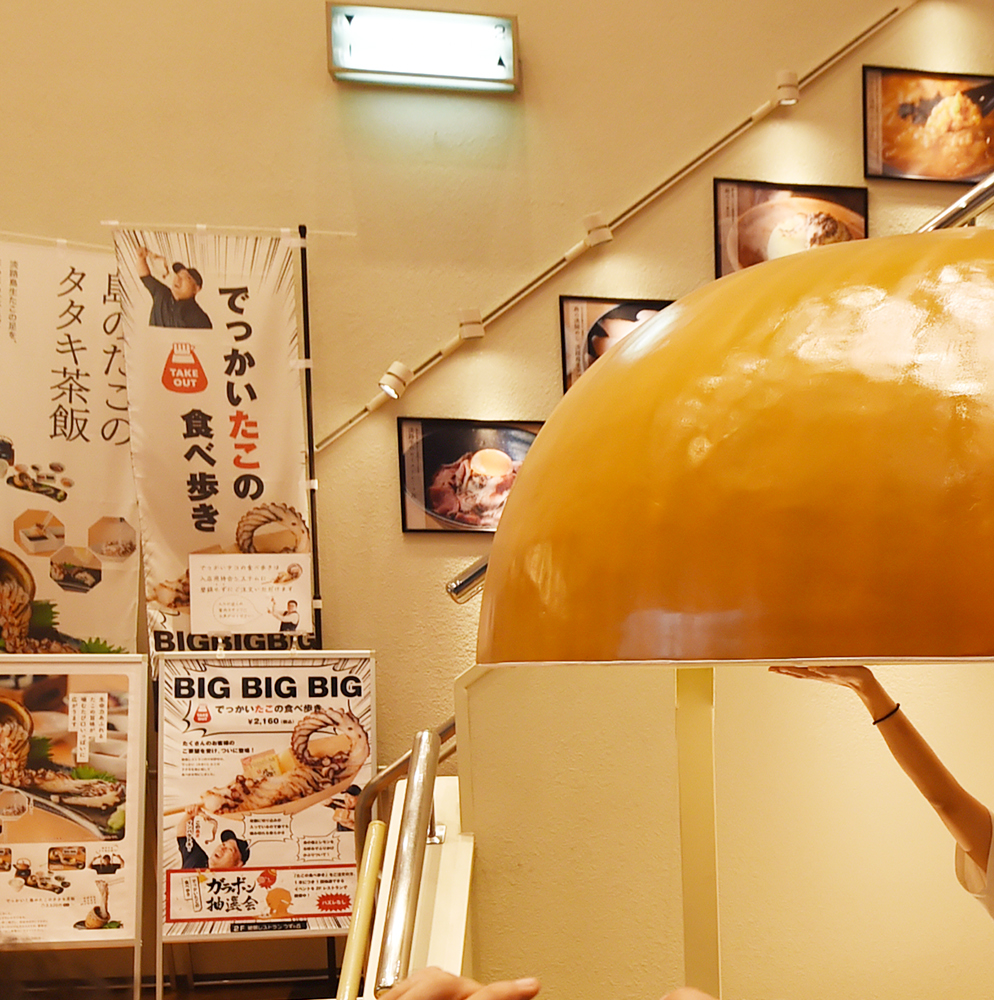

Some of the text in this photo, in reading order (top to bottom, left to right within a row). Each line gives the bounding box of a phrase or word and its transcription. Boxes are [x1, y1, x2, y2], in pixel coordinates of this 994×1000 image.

[49, 265, 91, 443] タタキ茶飯
[169, 368, 199, 378] TAKE
[173, 378, 198, 388] OUT
[218, 285, 265, 501] でっかいたこの
[180, 408, 220, 533] 食べ歩き
[174, 675, 362, 699] BIG BIG BIG
[215, 703, 322, 714] でっかいたこの食べ歩き
[205, 894, 259, 913] 抽選会
